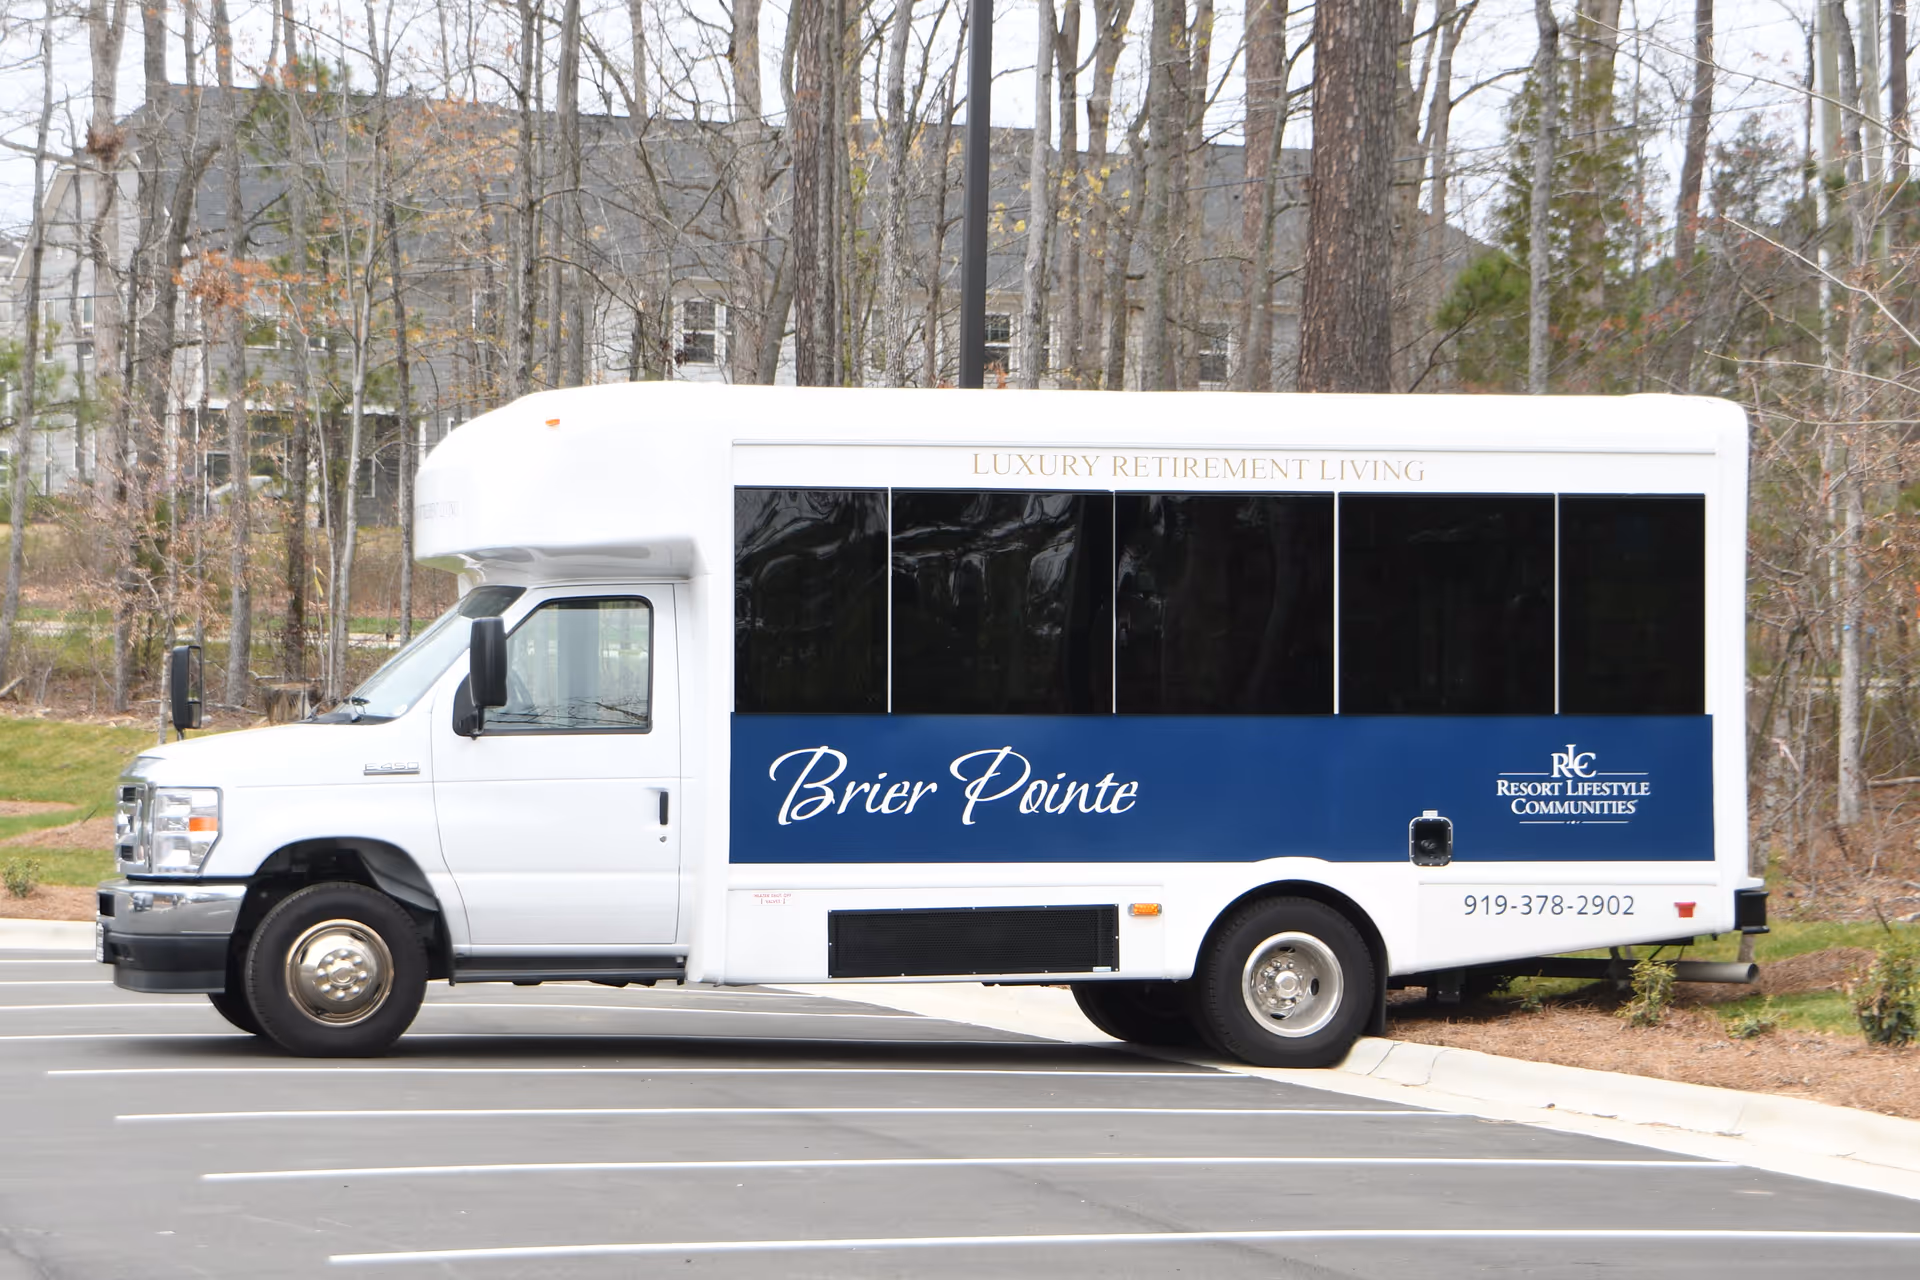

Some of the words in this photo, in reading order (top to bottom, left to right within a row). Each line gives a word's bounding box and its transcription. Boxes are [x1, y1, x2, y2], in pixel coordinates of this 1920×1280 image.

[974, 453, 1101, 477] LUXURY
[1113, 456, 1310, 480] RETIREMENT
[1321, 459, 1425, 482] LIVING
[769, 745, 938, 826] Brier
[950, 745, 1139, 826] Pointe
[1464, 894, 1635, 916] 919-378-2902
